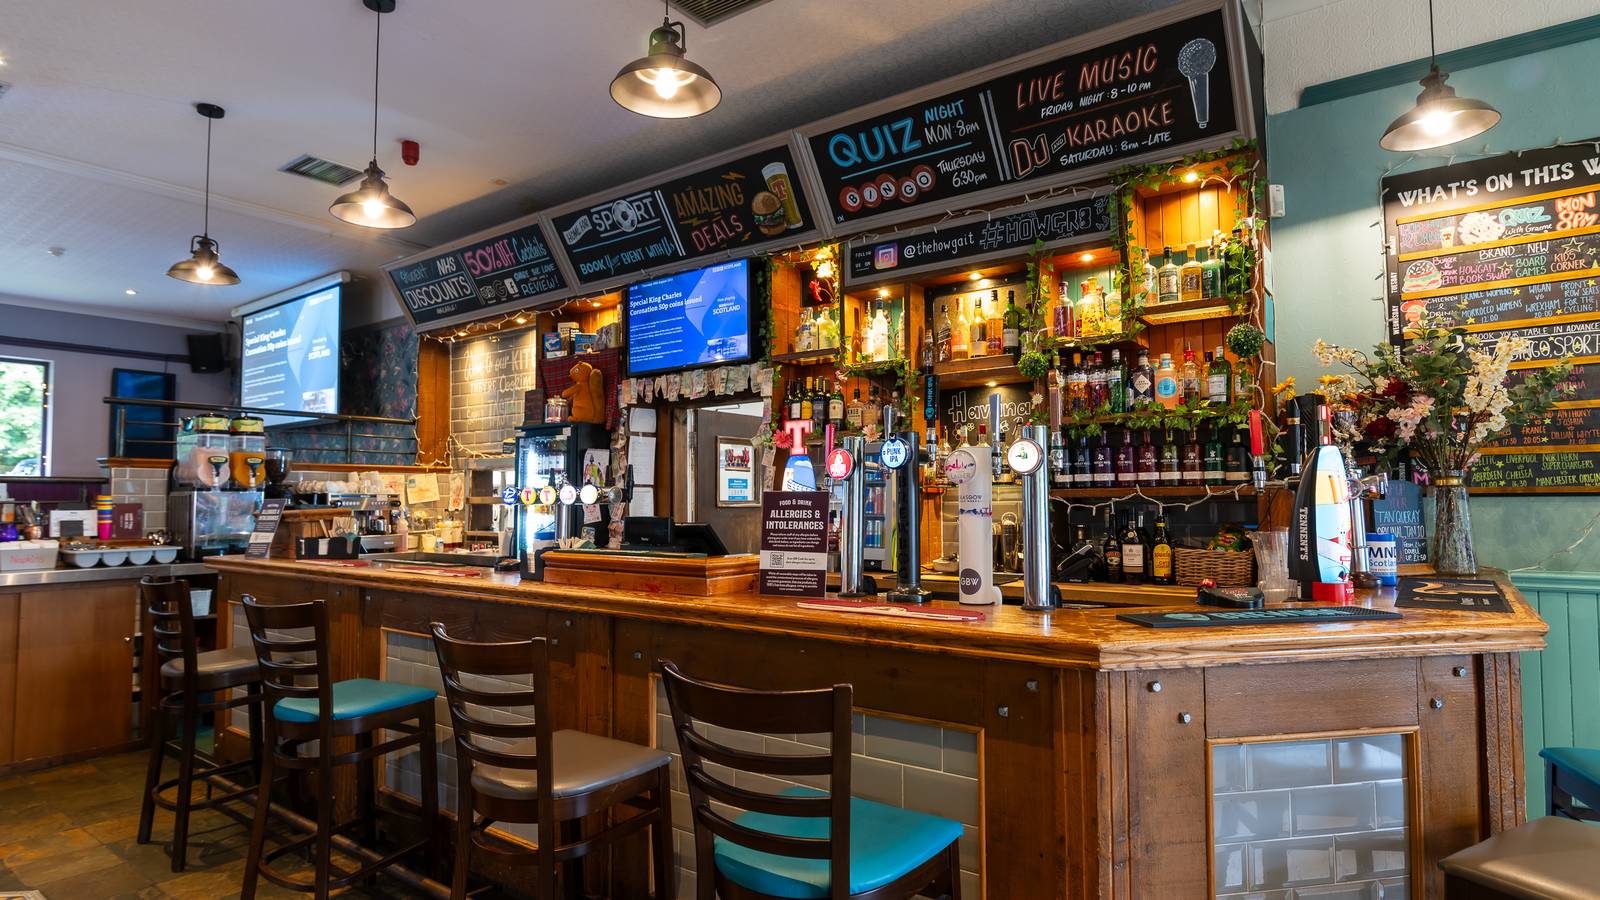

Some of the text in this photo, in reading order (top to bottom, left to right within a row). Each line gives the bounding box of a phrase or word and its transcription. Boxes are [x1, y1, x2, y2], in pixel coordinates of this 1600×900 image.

[1016, 46, 1158, 110] LIVE MUSIC
[1041, 101, 1073, 119] FRIDAY
[1079, 92, 1104, 107] NIGHT
[829, 99, 965, 167] QUIZ NIGHT
[1010, 134, 1049, 178] DJ
[1067, 101, 1175, 147] KARAOKE
[937, 151, 986, 175] THURSDAY
[848, 173, 929, 205] BINGO
[1398, 179, 1479, 207] WHAT'S
[1486, 173, 1513, 193] ON
[1521, 162, 1575, 187] THIS
[673, 182, 745, 218] AMAZING
[1555, 192, 1597, 211] MON
[1555, 211, 1600, 231] 8PM
[691, 215, 743, 252] DEALS
[904, 232, 975, 258] @thehowgait
[1480, 241, 1549, 260] BRAND NEW
[580, 259, 607, 275] BOOK
[621, 247, 645, 265] EVENT
[1516, 255, 1547, 267] BOARD
[1554, 251, 1576, 262] KIDS
[436, 256, 457, 276] NHS
[1459, 262, 1498, 275] HOWGAIT
[1516, 266, 1547, 278] GAMES
[1551, 259, 1587, 272] CORNER
[1459, 275, 1484, 285] BOOK
[1560, 280, 1587, 290] FRONT
[405, 276, 471, 309] DISCOUNTS
[1565, 285, 1600, 297] ROW SEATS
[629, 292, 682, 308] Special King Charles
[629, 304, 658, 316] Coronation
[658, 303, 669, 312] 50p
[669, 300, 684, 308] coins
[1497, 299, 1522, 311] WOMENS
[1525, 299, 1560, 312] WREXHAM
[1565, 296, 1594, 306] FOR THE
[712, 304, 741, 316] SCOTLAND
[1521, 326, 1549, 336] TABLE
[1553, 324, 1563, 333] IN
[1566, 321, 1600, 332] ADVANCE
[948, 391, 1032, 422] Havna
[1472, 470, 1503, 482] ABERDEEN
[1505, 469, 1533, 480] CHELSEA
[1535, 475, 1577, 486] MANCHESTER
[770, 509, 821, 519] ALLERGIES &
[766, 520, 824, 530] INTOLERANCES
[1299, 506, 1309, 561] TENNENT'S
[960, 577, 979, 587] GBW
